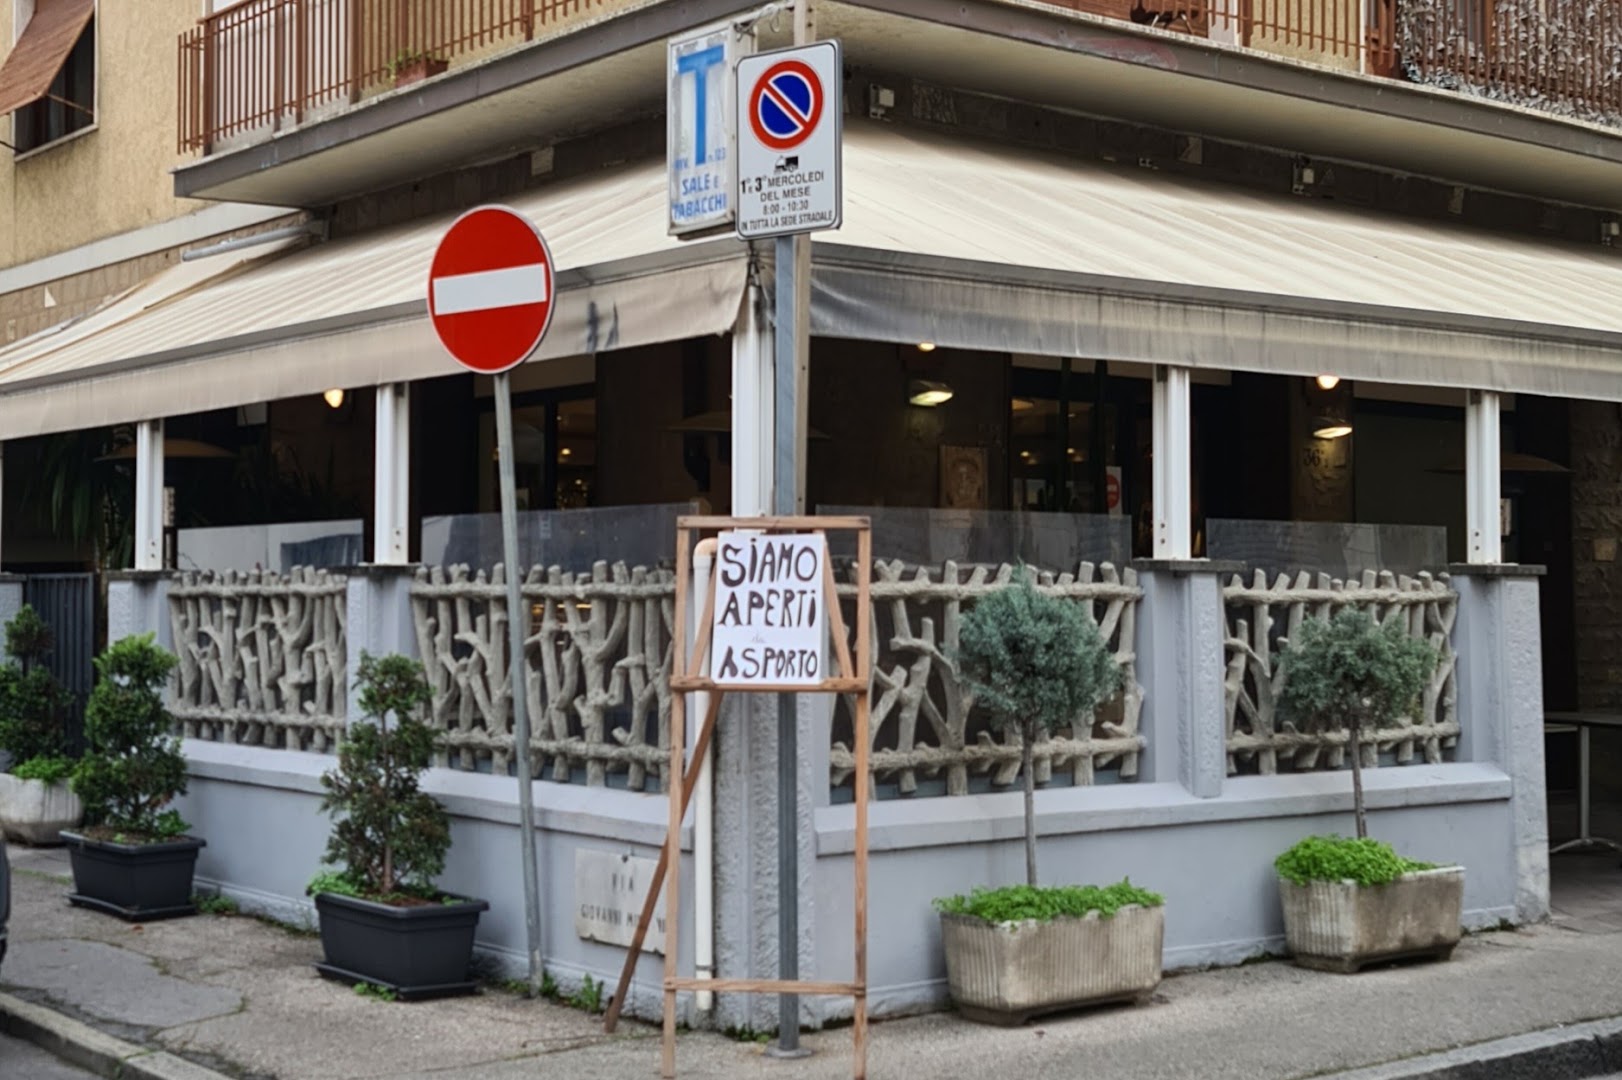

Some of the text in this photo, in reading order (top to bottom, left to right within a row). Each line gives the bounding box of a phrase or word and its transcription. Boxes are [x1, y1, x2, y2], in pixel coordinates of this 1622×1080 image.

[679, 44, 724, 166] T
[681, 173, 710, 196] SALE
[760, 186, 811, 202] DEL MESE
[672, 193, 727, 219] TABACCHI
[763, 203, 780, 216] 8:00
[749, 218, 769, 231] TUTTA
[770, 216, 779, 228] LA
[780, 213, 797, 227] SEDE
[798, 210, 833, 224] STRADALE
[718, 645, 819, 679] ASPORTO
